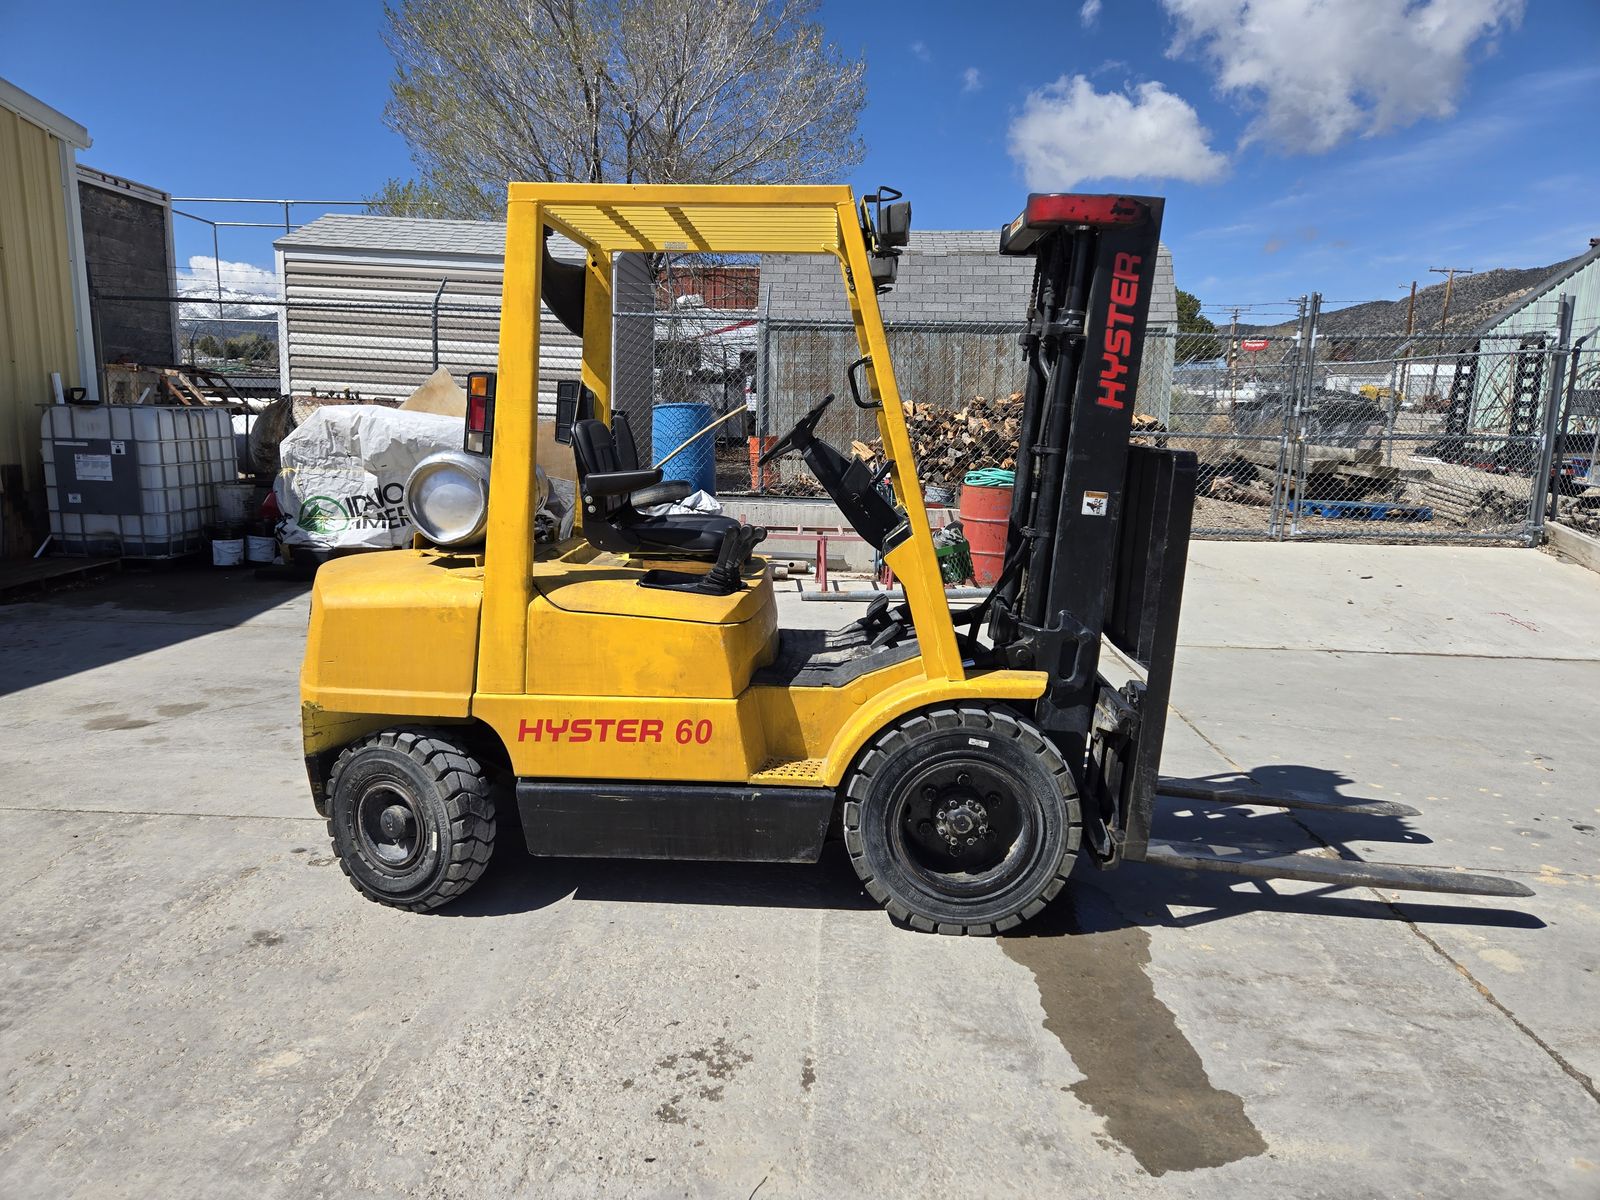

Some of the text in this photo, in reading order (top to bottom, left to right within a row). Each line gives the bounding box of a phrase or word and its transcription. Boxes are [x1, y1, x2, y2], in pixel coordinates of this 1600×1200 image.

[1096, 252, 1142, 409] HYSTER
[518, 719, 713, 744] HYSTER 60
